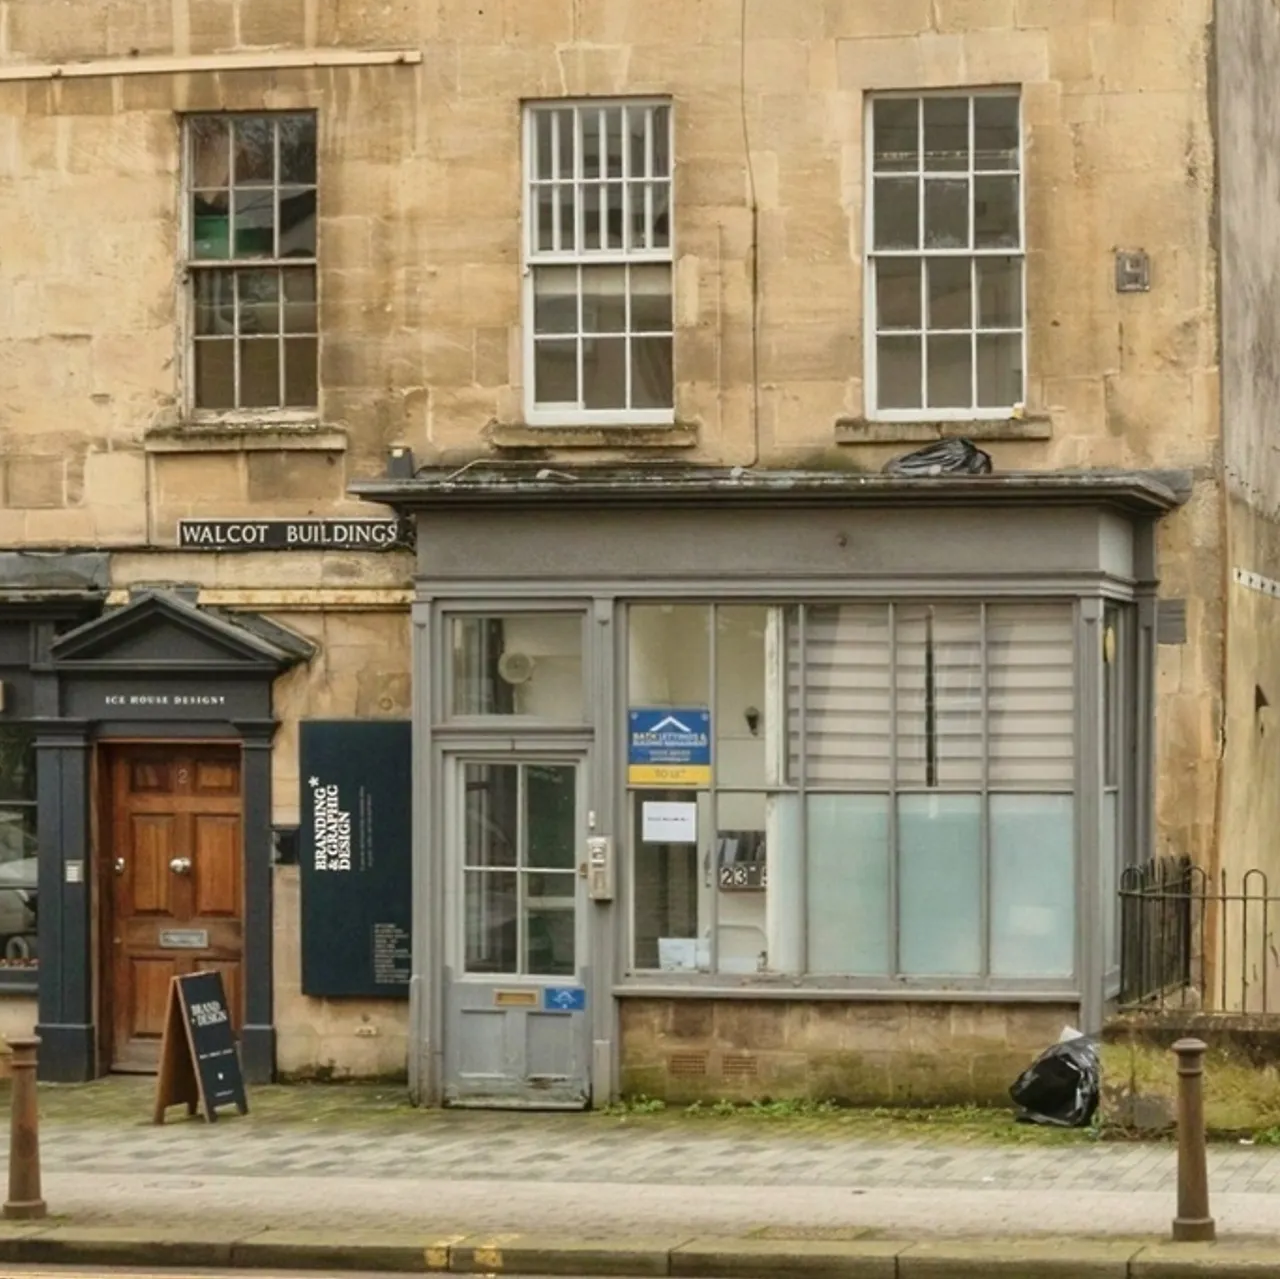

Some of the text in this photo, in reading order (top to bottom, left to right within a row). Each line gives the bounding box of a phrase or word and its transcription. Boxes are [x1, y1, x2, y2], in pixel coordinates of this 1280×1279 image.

[182, 524, 398, 543] WALCOT BUILDINGS
[326, 784, 339, 871] & GRAPHIC
[338, 811, 351, 870] DESIGN
